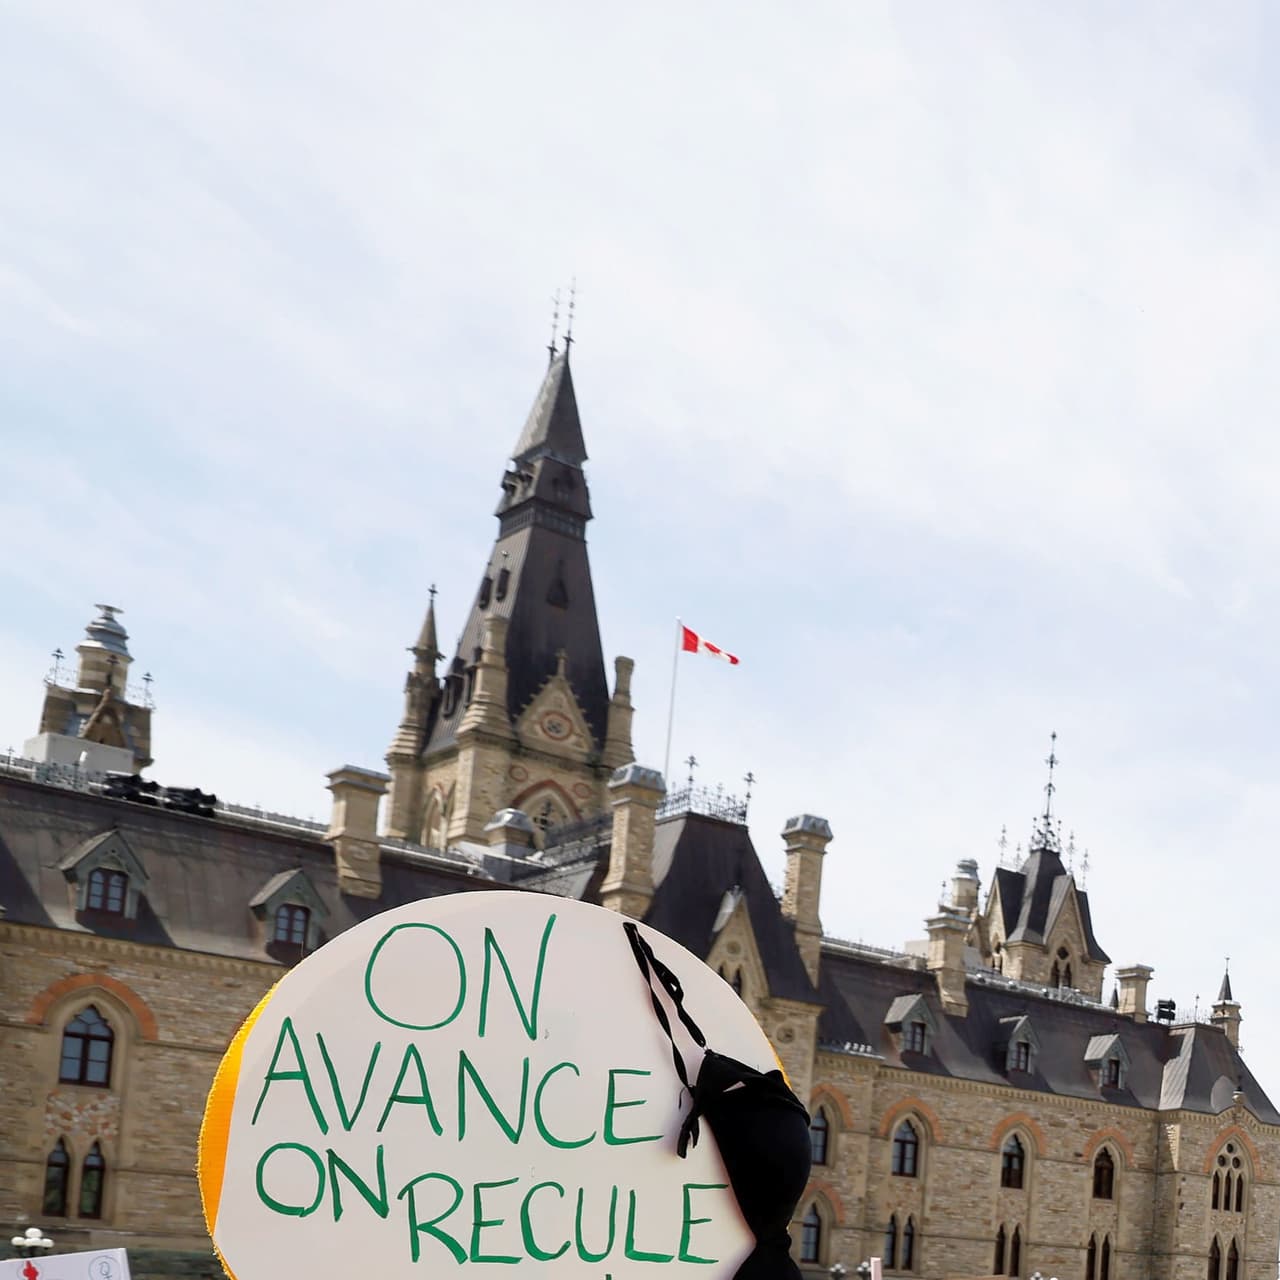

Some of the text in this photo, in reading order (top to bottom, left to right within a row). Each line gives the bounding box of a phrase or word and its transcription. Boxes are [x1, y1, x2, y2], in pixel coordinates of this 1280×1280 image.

[365, 914, 558, 1040] ON
[253, 1016, 662, 1151] AVANCE
[255, 1141, 729, 1265] ON RECULE
